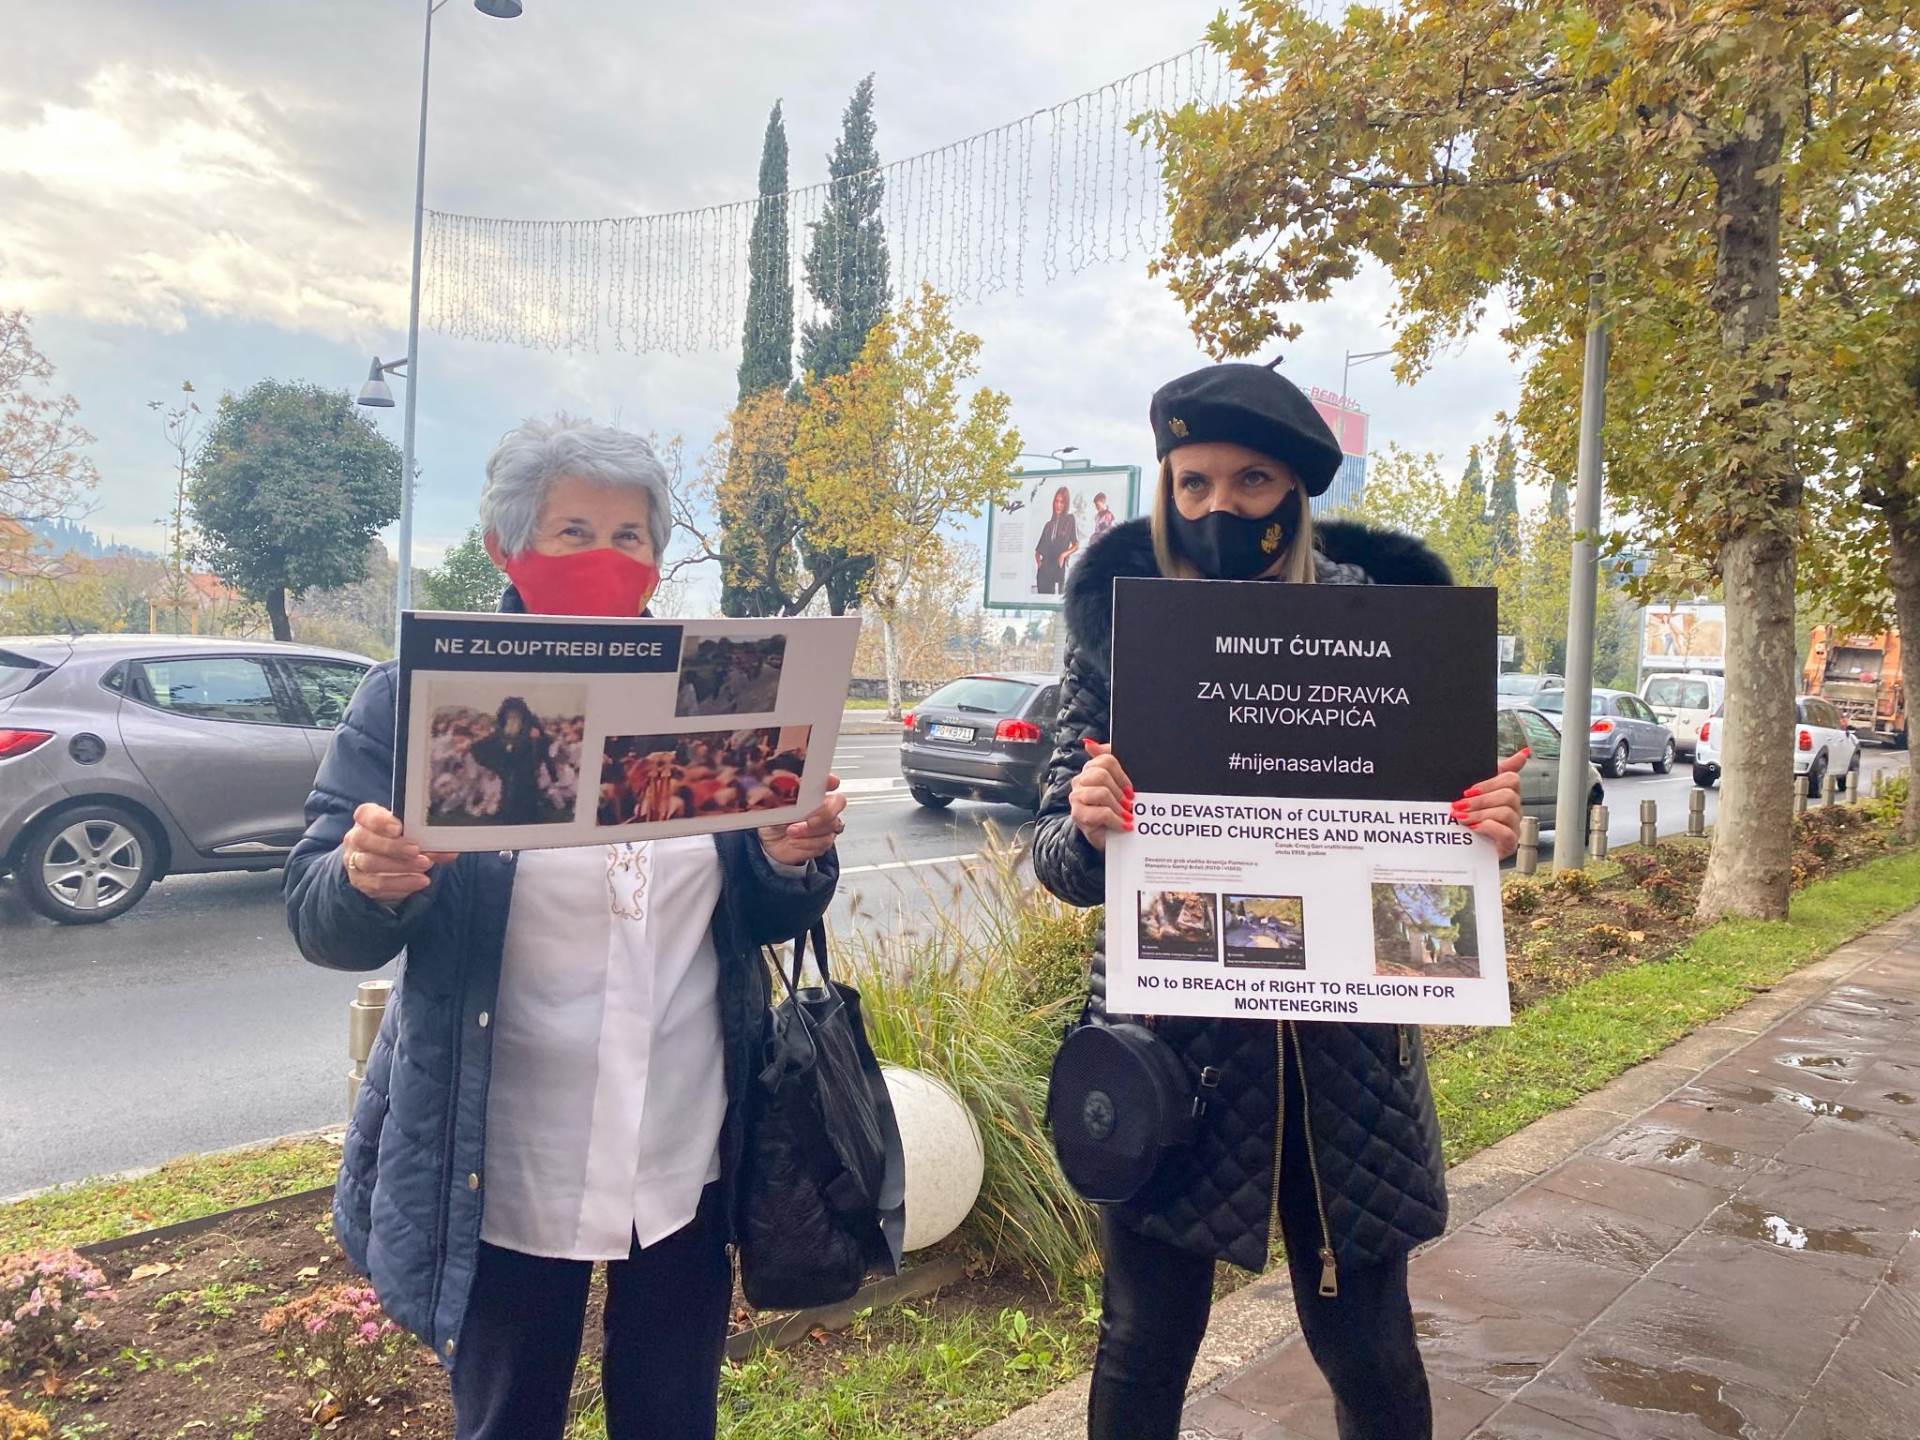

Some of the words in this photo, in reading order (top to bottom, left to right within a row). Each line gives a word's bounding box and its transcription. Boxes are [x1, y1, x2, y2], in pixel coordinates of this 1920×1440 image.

[435, 639, 463, 653] NE
[470, 640, 603, 656] ZLOUPTREBI
[609, 643, 662, 656] ĐECE
[1216, 637, 1283, 654] MINUT
[1290, 635, 1391, 657] ĆUTANJA
[1198, 682, 1224, 699] ZA
[1230, 683, 1300, 701] VLADU
[1308, 686, 1409, 704] ZDRAVKA
[1230, 706, 1376, 726] KRIVOKAPIĆA
[1229, 753, 1373, 774] #nijenasavlada
[1129, 803, 1146, 815] O
[1151, 805, 1165, 816] to
[1172, 805, 1281, 820] DEVASTATION
[1288, 809, 1302, 821] of
[1308, 810, 1394, 823] CULTURAL
[1400, 812, 1460, 825] HERITA
[1138, 823, 1222, 837] OCCUPIED
[1228, 826, 1318, 840] CHURCHES
[1324, 829, 1358, 841] AND
[1364, 830, 1472, 845] MONASTRIES
[1138, 976, 1159, 987] NO
[1164, 978, 1177, 988] to
[1183, 978, 1245, 991] BREACH
[1251, 980, 1264, 991] of
[1270, 981, 1315, 993] RIGHT
[1320, 982, 1340, 994] TO
[1346, 983, 1418, 996] RELIGION
[1424, 986, 1454, 997] FOR
[1235, 998, 1357, 1013] MONTENEGRINS
